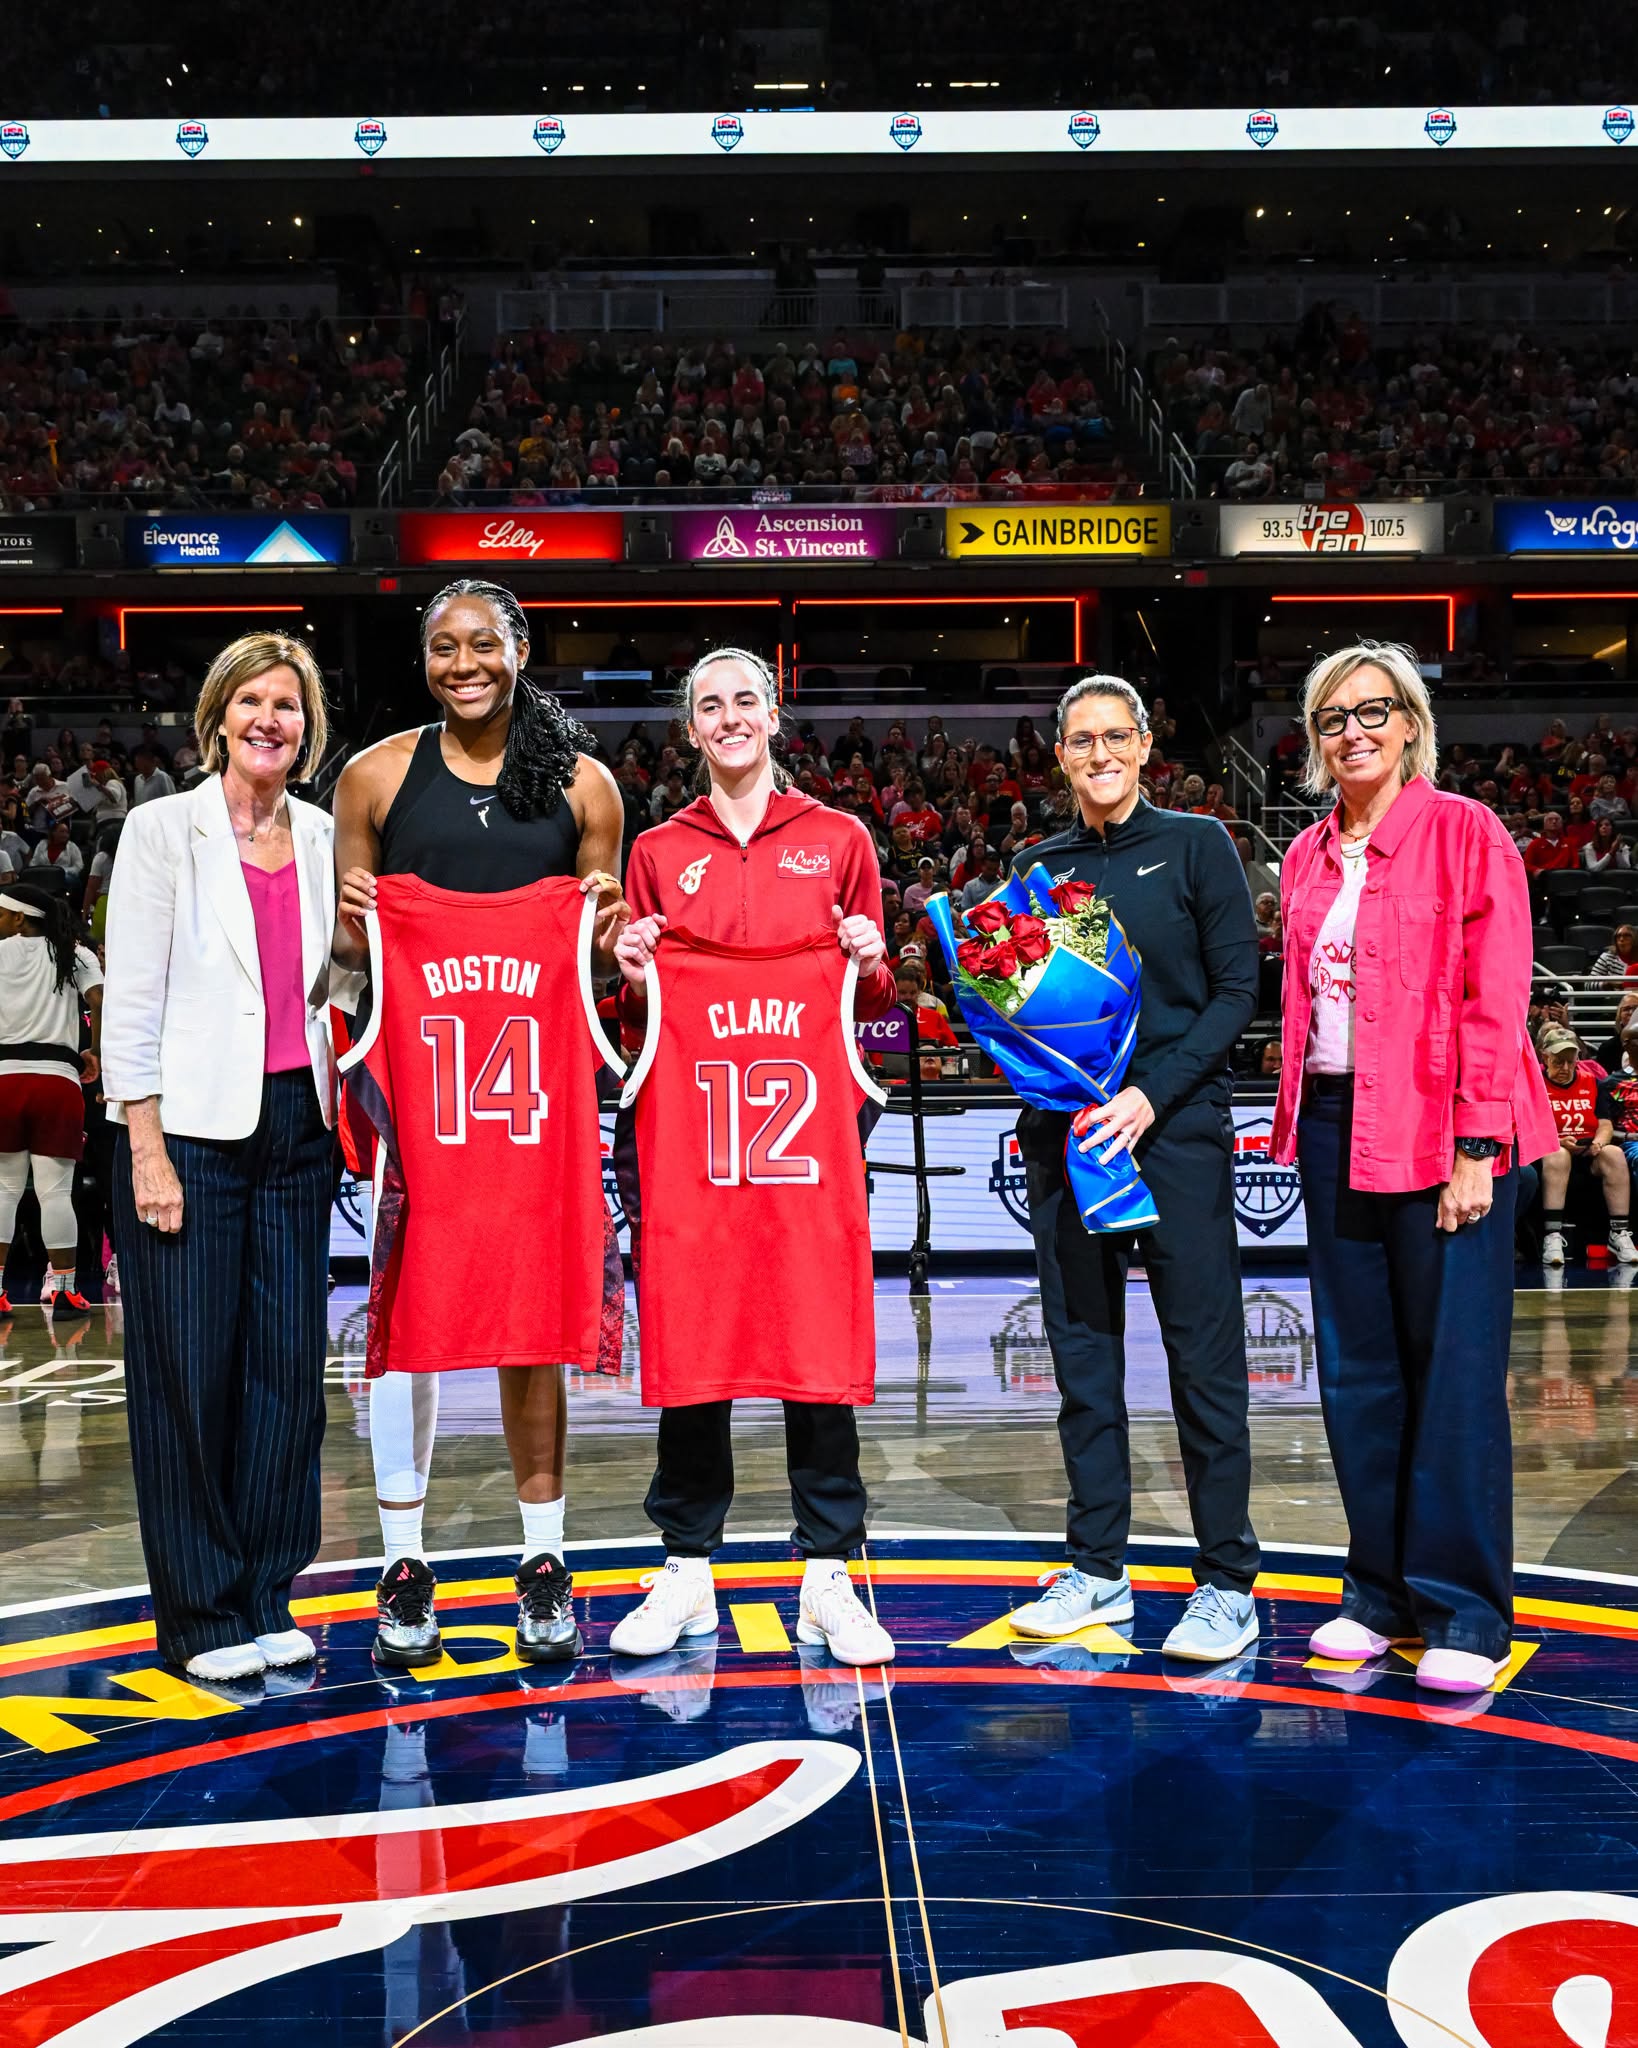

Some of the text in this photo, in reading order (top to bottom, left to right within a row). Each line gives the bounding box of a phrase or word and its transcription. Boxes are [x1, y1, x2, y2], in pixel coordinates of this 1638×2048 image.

[717, 120, 737, 129] USA
[896, 118, 916, 128] USA
[1074, 117, 1094, 127] USA
[1252, 115, 1272, 125] USA
[1431, 114, 1450, 124] USA
[1608, 112, 1628, 122] USA
[4, 128, 23, 137] USA
[182, 126, 202, 135] USA
[361, 124, 380, 134] USA
[539, 122, 559, 131] USA
[755, 513, 864, 532] Ascension
[1297, 504, 1350, 530] the
[993, 517, 1158, 546] GAINBRIDGE
[1262, 519, 1293, 538] 93.5
[1370, 519, 1404, 537] 107.5
[1582, 505, 1638, 549] Krog
[0, 537, 32, 546] TORS
[144, 530, 219, 545] Elevance
[478, 520, 544, 557] Lilly
[1310, 527, 1365, 551] fan
[180, 545, 220, 556] Health
[755, 538, 868, 557] St. Vincent
[421, 955, 541, 998] BOSTON
[707, 998, 806, 1039] CLARK
[420, 1015, 548, 1144] 14
[696, 1059, 819, 1186] 12
[1561, 1113, 1585, 1131] 22
